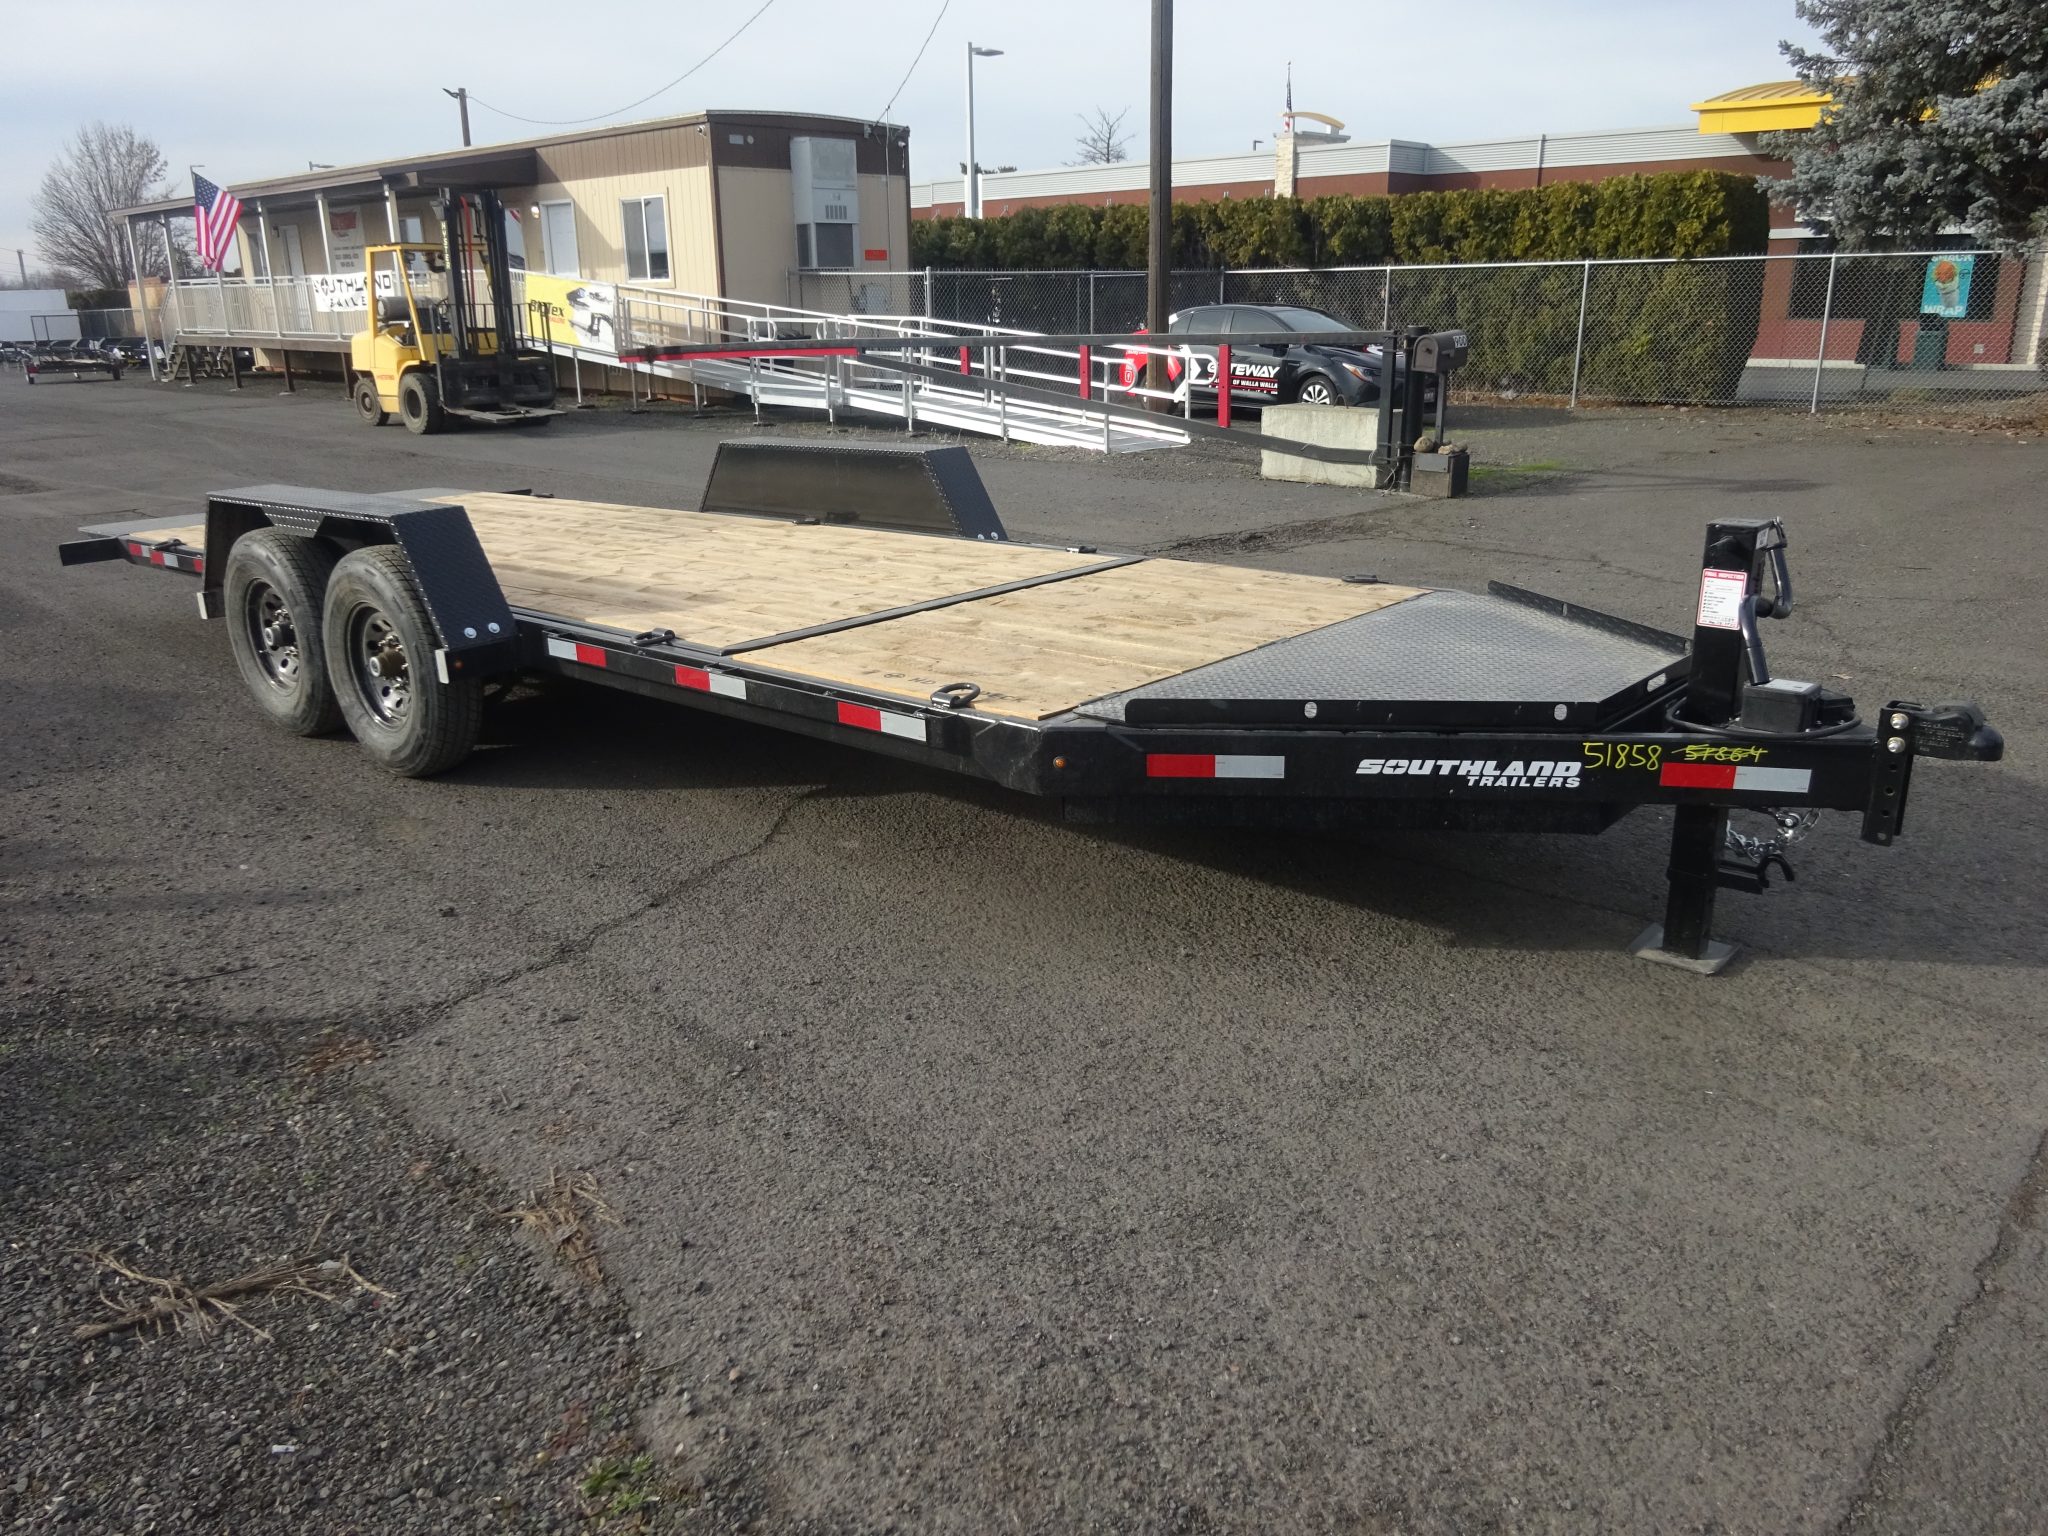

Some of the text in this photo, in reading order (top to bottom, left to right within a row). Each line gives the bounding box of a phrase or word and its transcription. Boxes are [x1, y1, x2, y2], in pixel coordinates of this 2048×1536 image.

[441, 221, 451, 270] HYSTER
[1924, 304, 1963, 315] WRAP
[1207, 361, 1280, 378] GTEWAY
[1583, 743, 1662, 771] 51858
[1355, 758, 1583, 777] SOUTHLAND
[1466, 776, 1582, 788] TRAILERS
